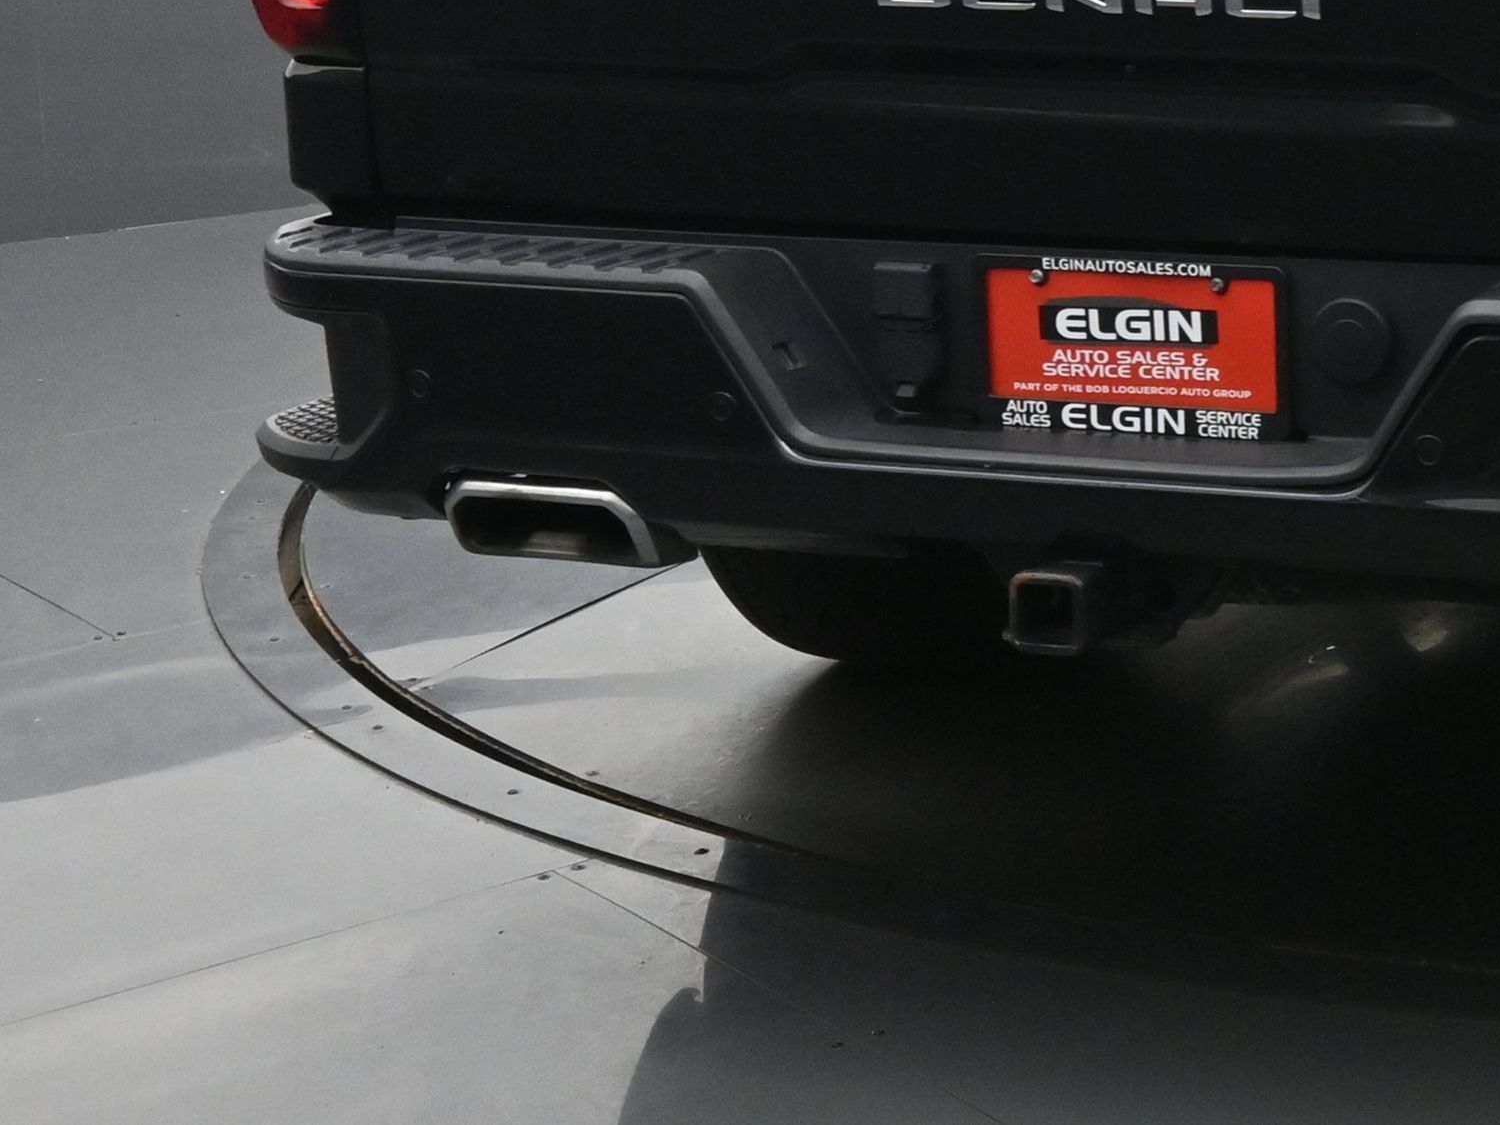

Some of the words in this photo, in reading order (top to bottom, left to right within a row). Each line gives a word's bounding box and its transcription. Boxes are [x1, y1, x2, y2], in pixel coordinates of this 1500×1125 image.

[1042, 257, 1211, 277] ELGINAUTOSALES.COM
[1055, 307, 1203, 342] ELGIN
[1052, 349, 1108, 364] AUTO
[1116, 350, 1185, 365] SALES
[1192, 353, 1208, 366] &
[1042, 362, 1131, 378] SERVICE
[1138, 364, 1220, 381] CENTER
[1014, 382, 1040, 391] PART
[1044, 382, 1058, 392] OF
[1063, 384, 1083, 393] THE
[1086, 385, 1109, 394] BOB
[1112, 386, 1177, 396] LOQUERCIO
[1181, 387, 1210, 397] AUTO
[1213, 389, 1251, 399] GROUP
[1006, 399, 1047, 413] AUTO
[1002, 413, 1050, 427] SALES
[1061, 403, 1185, 435] ELGIN
[1196, 410, 1261, 426] SERVICE
[1199, 424, 1258, 439] CENTER
